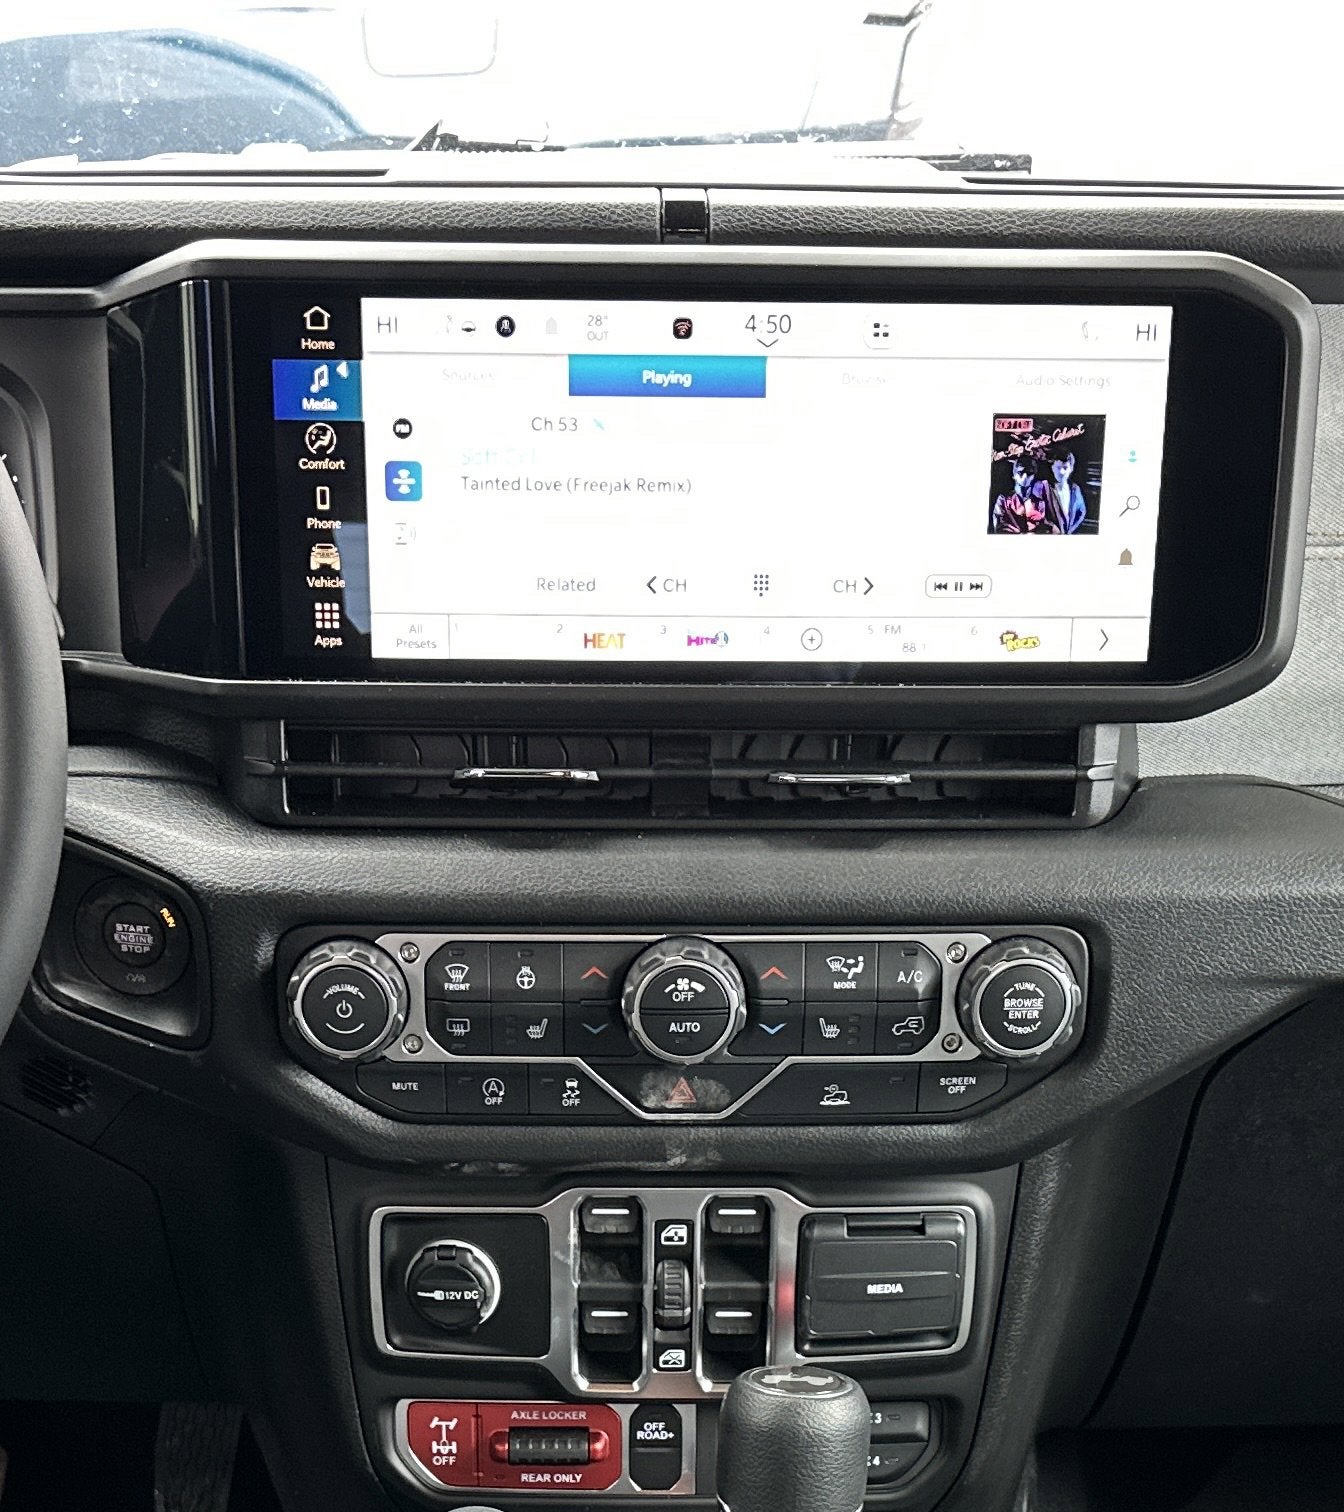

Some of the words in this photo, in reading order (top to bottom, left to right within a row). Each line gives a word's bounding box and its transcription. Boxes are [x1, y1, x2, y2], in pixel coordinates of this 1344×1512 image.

[377, 315, 398, 333] HI
[744, 314, 792, 333] 4:50
[587, 331, 608, 341] OUT
[1135, 323, 1157, 341] HI
[301, 337, 336, 350] Home
[642, 369, 693, 388] Playing
[1059, 373, 1111, 389] Settings
[301, 397, 338, 411] Media
[531, 416, 553, 432] Ch
[558, 416, 579, 432] 53
[298, 458, 345, 470] Comfort
[460, 476, 521, 493] Tainted
[525, 477, 562, 492] Love
[566, 477, 632, 495] (Freejak
[637, 477, 693, 494] Remix)
[306, 517, 342, 530] Phone
[306, 575, 346, 588] Vehicle
[536, 577, 596, 592] Related
[662, 578, 688, 593] CH
[833, 579, 857, 594] CH
[408, 623, 424, 634] All
[884, 624, 902, 635] FM
[314, 634, 343, 648] Apps
[396, 638, 437, 650] Presets
[583, 633, 626, 649] HEAT
[159, 907, 176, 929] RUN
[115, 922, 150, 934] START
[113, 933, 154, 944] ENGINE
[120, 943, 151, 954] STOP
[896, 969, 924, 985] A/C
[325, 983, 360, 996] VOLUME
[444, 983, 471, 991] FRONT
[833, 981, 858, 989] MODE
[1013, 981, 1036, 991] TUNE
[672, 991, 695, 1002] OFF
[1004, 998, 1044, 1008] BROWSE
[1008, 1010, 1040, 1019] ENTER
[668, 1021, 702, 1033] AUTO
[1007, 1024, 1038, 1035] SCROLL
[391, 1081, 419, 1091] MUTE
[939, 1076, 977, 1086] SCREEN
[948, 1085, 967, 1095] OFF
[484, 1096, 503, 1106] OFF
[562, 1097, 581, 1107] OFF
[866, 1282, 904, 1295] MEDIA
[445, 1289, 465, 1301] 12V
[466, 1289, 480, 1301] DC
[510, 1410, 541, 1420] AXLE
[542, 1410, 588, 1421] LOCKER
[643, 1422, 666, 1432] OFF
[636, 1430, 676, 1441] ROAD+
[432, 1455, 456, 1466] OFF
[520, 1473, 552, 1484] REAR
[553, 1472, 583, 1484] ONLY
